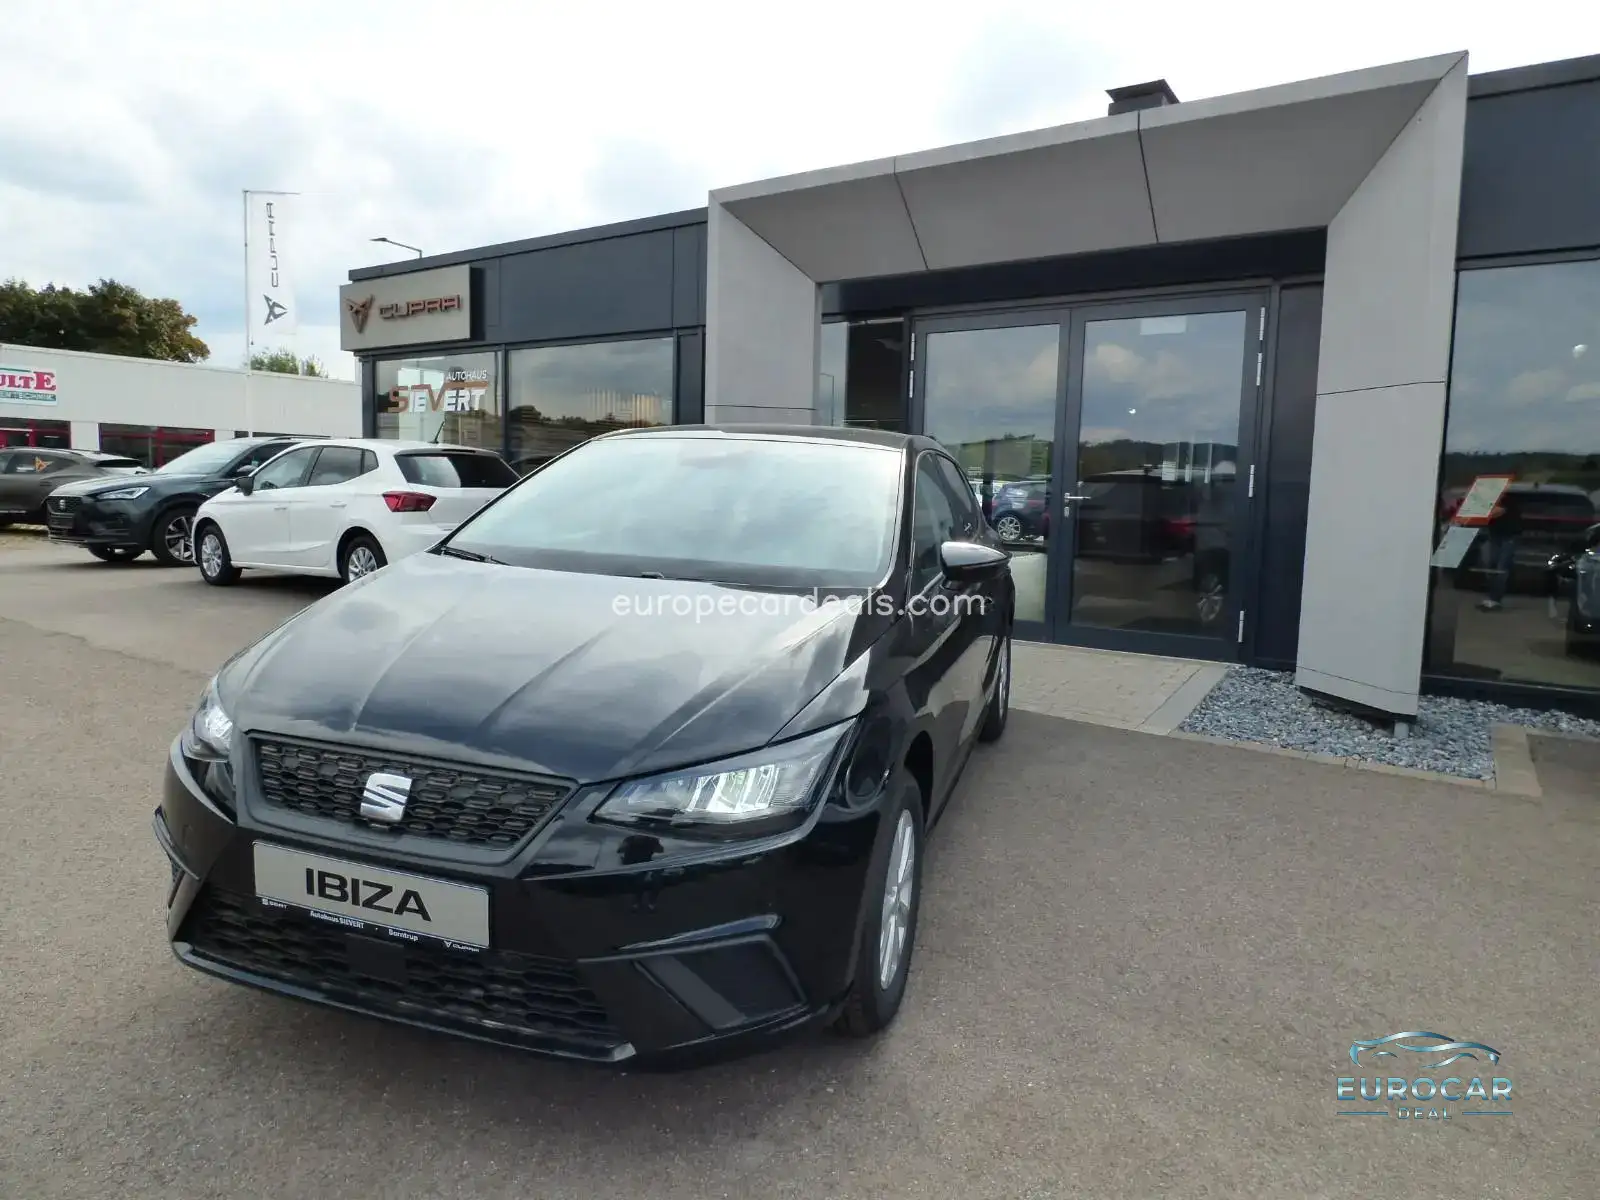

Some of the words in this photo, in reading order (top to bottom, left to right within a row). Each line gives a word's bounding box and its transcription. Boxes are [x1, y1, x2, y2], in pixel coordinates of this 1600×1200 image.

[380, 295, 462, 320] CUPRA
[446, 369, 488, 381] AUTOHAUS
[388, 381, 489, 413] SIEVERT
[305, 867, 432, 922] IBIZA
[309, 910, 340, 923] Autohaus
[339, 917, 364, 929] SIEVERT
